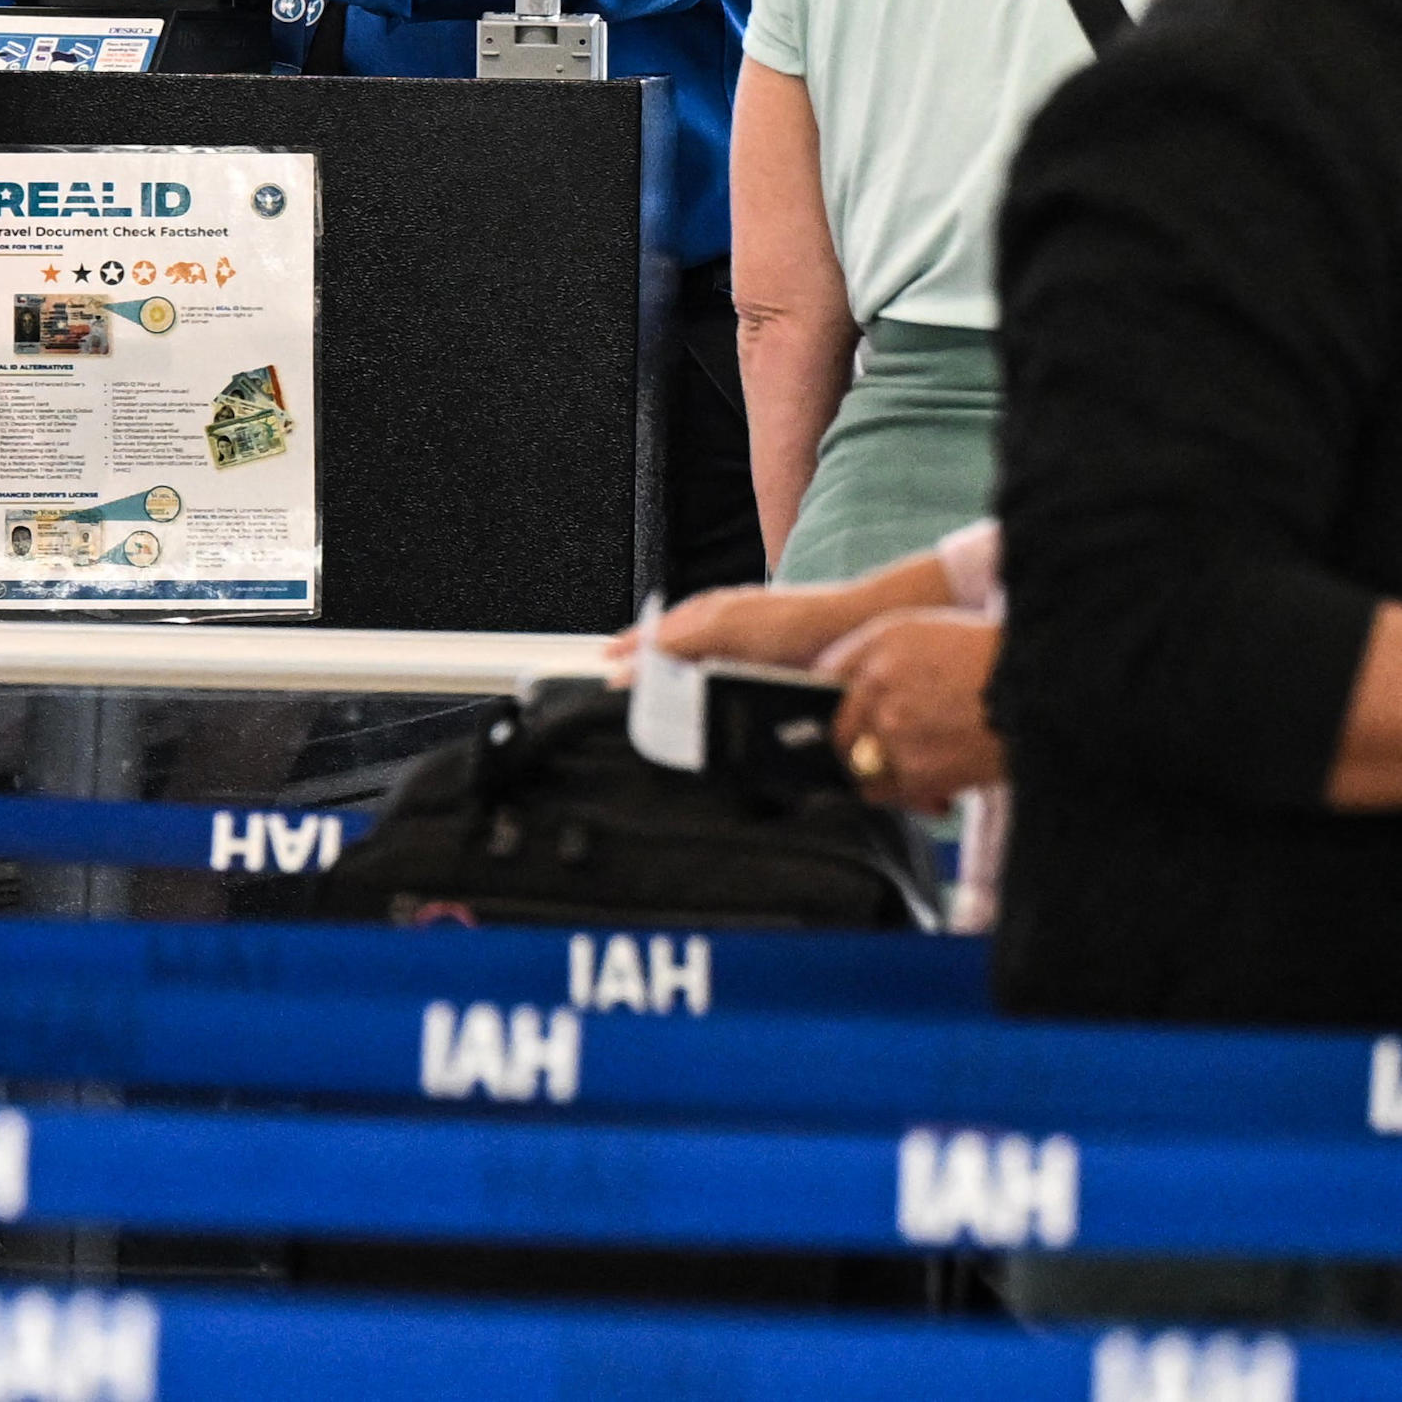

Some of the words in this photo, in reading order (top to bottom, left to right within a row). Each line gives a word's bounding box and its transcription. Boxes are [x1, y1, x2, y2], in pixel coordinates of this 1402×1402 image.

[36, 226, 109, 237] Document
[113, 226, 156, 237] Check
[161, 226, 229, 238] Factsheet
[141, 181, 191, 217] ID
[210, 811, 342, 873] IAH
[569, 935, 710, 1014] IAH
[420, 1000, 580, 1100] IAH
[896, 1127, 1079, 1248] IAH
